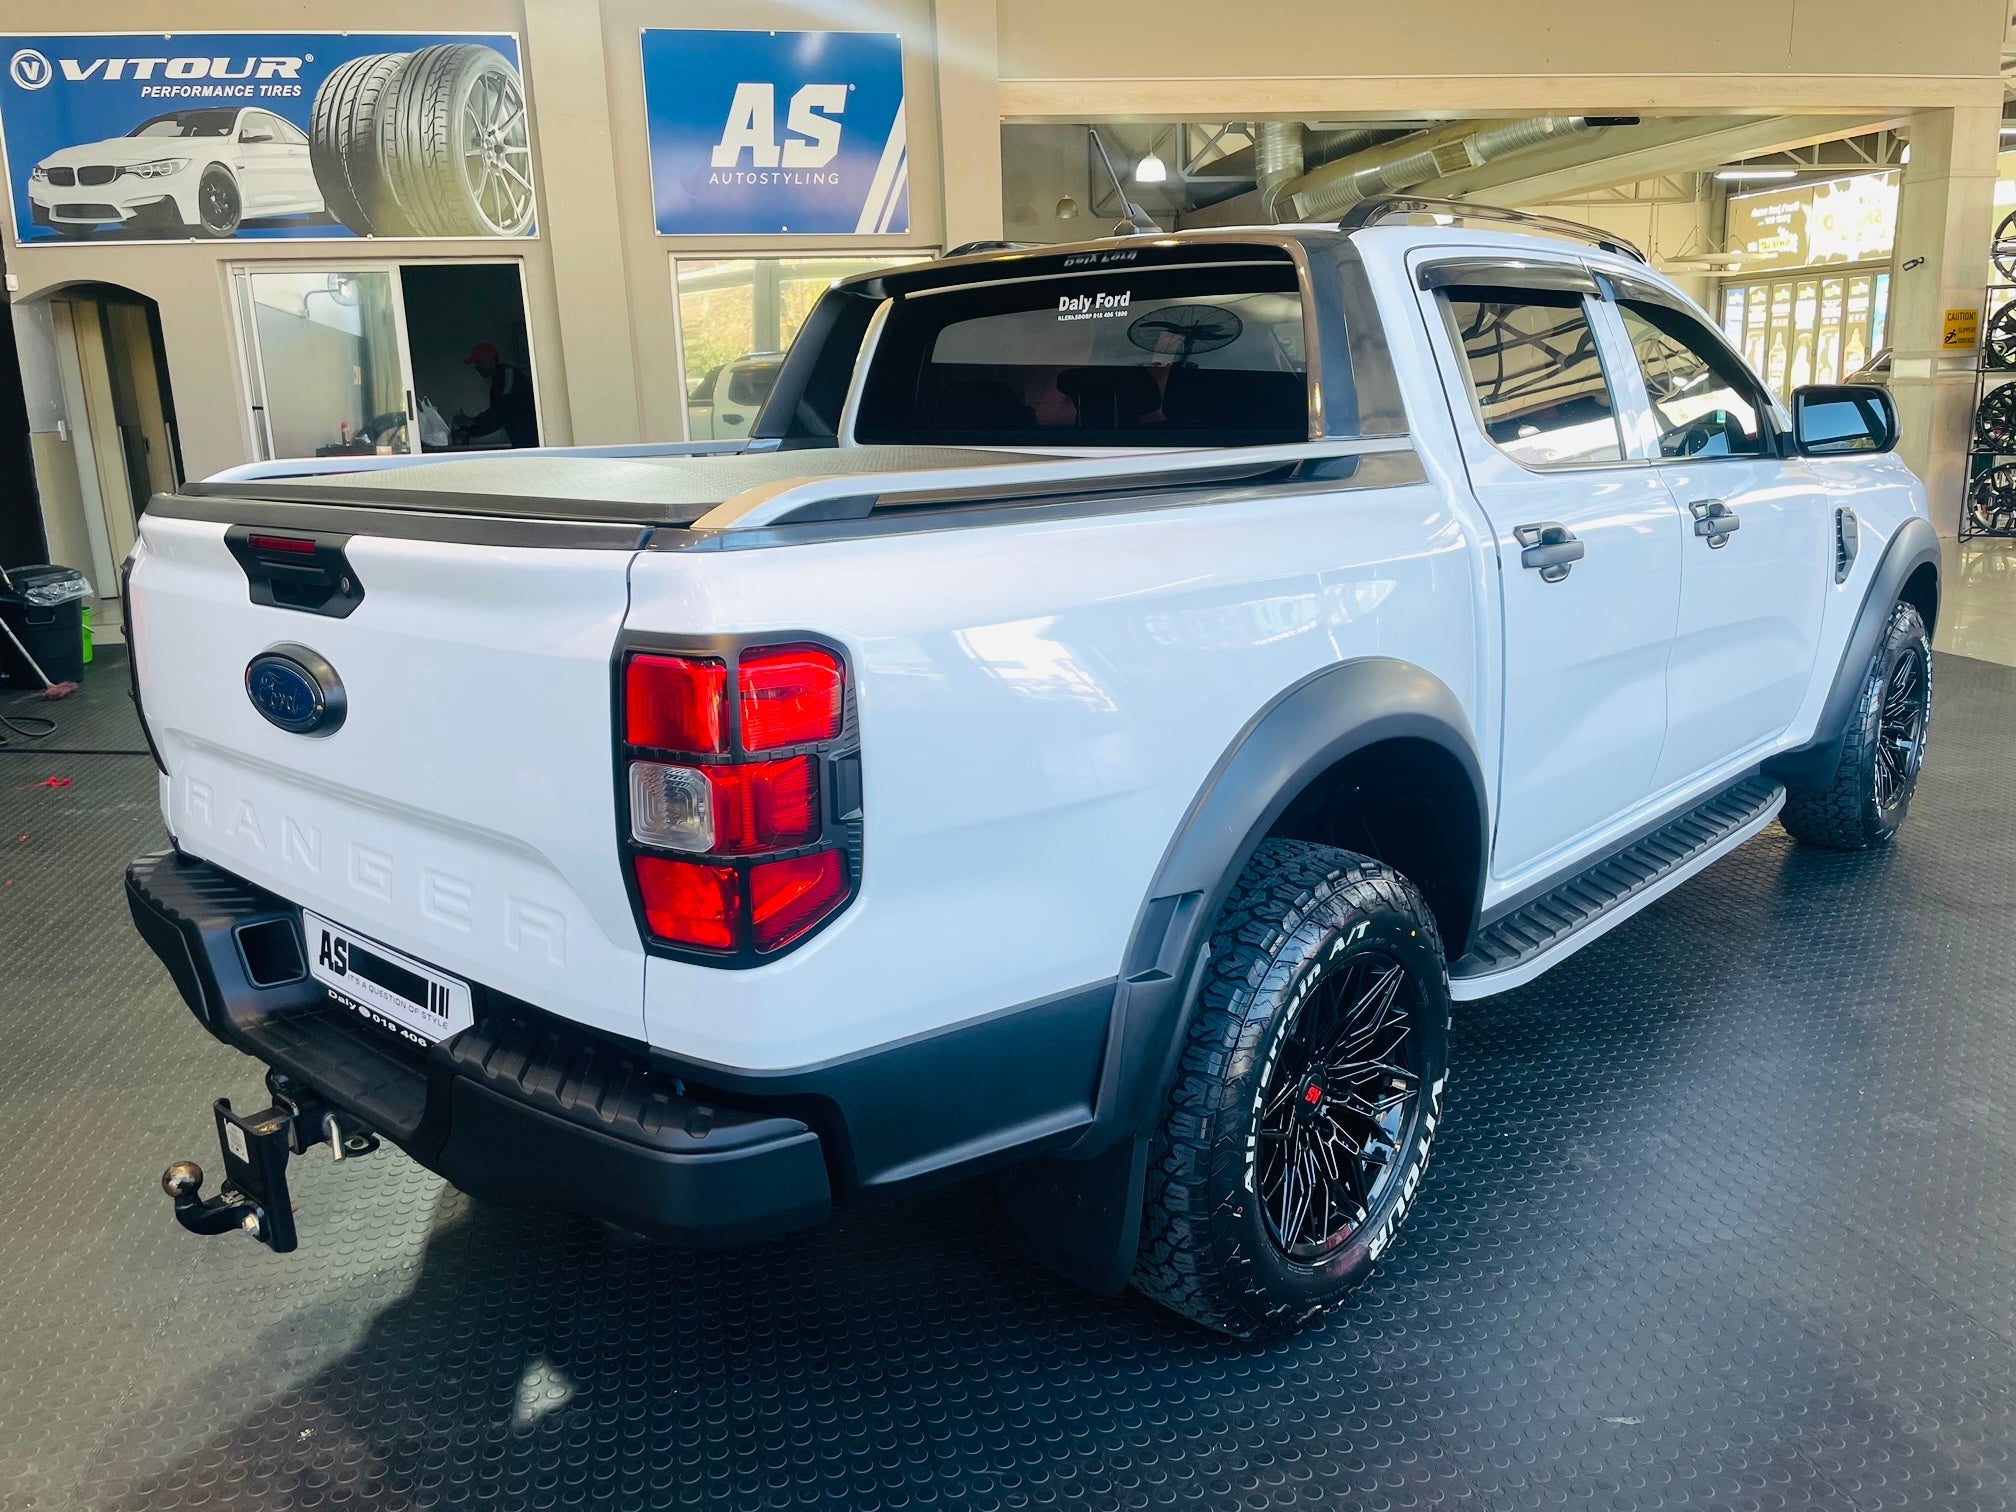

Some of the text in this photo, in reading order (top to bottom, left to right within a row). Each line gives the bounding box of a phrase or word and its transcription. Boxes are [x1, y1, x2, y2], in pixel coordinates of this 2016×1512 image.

[141, 85, 302, 98] PERFORMANCE TIRES
[710, 82, 848, 168] AS
[708, 172, 840, 185] AUTOSTYLING
[1058, 290, 1131, 314] Daly Ford
[258, 670, 301, 715] Ford
[184, 774, 567, 968] RANGER
[319, 929, 348, 977] AS
[1328, 920, 1371, 961] A/T
[328, 989, 428, 1048] Daly 018 406
[347, 974, 449, 1030] IT'S A QUESTION OF STYLE
[1367, 1077, 1444, 1262] VITOUR
